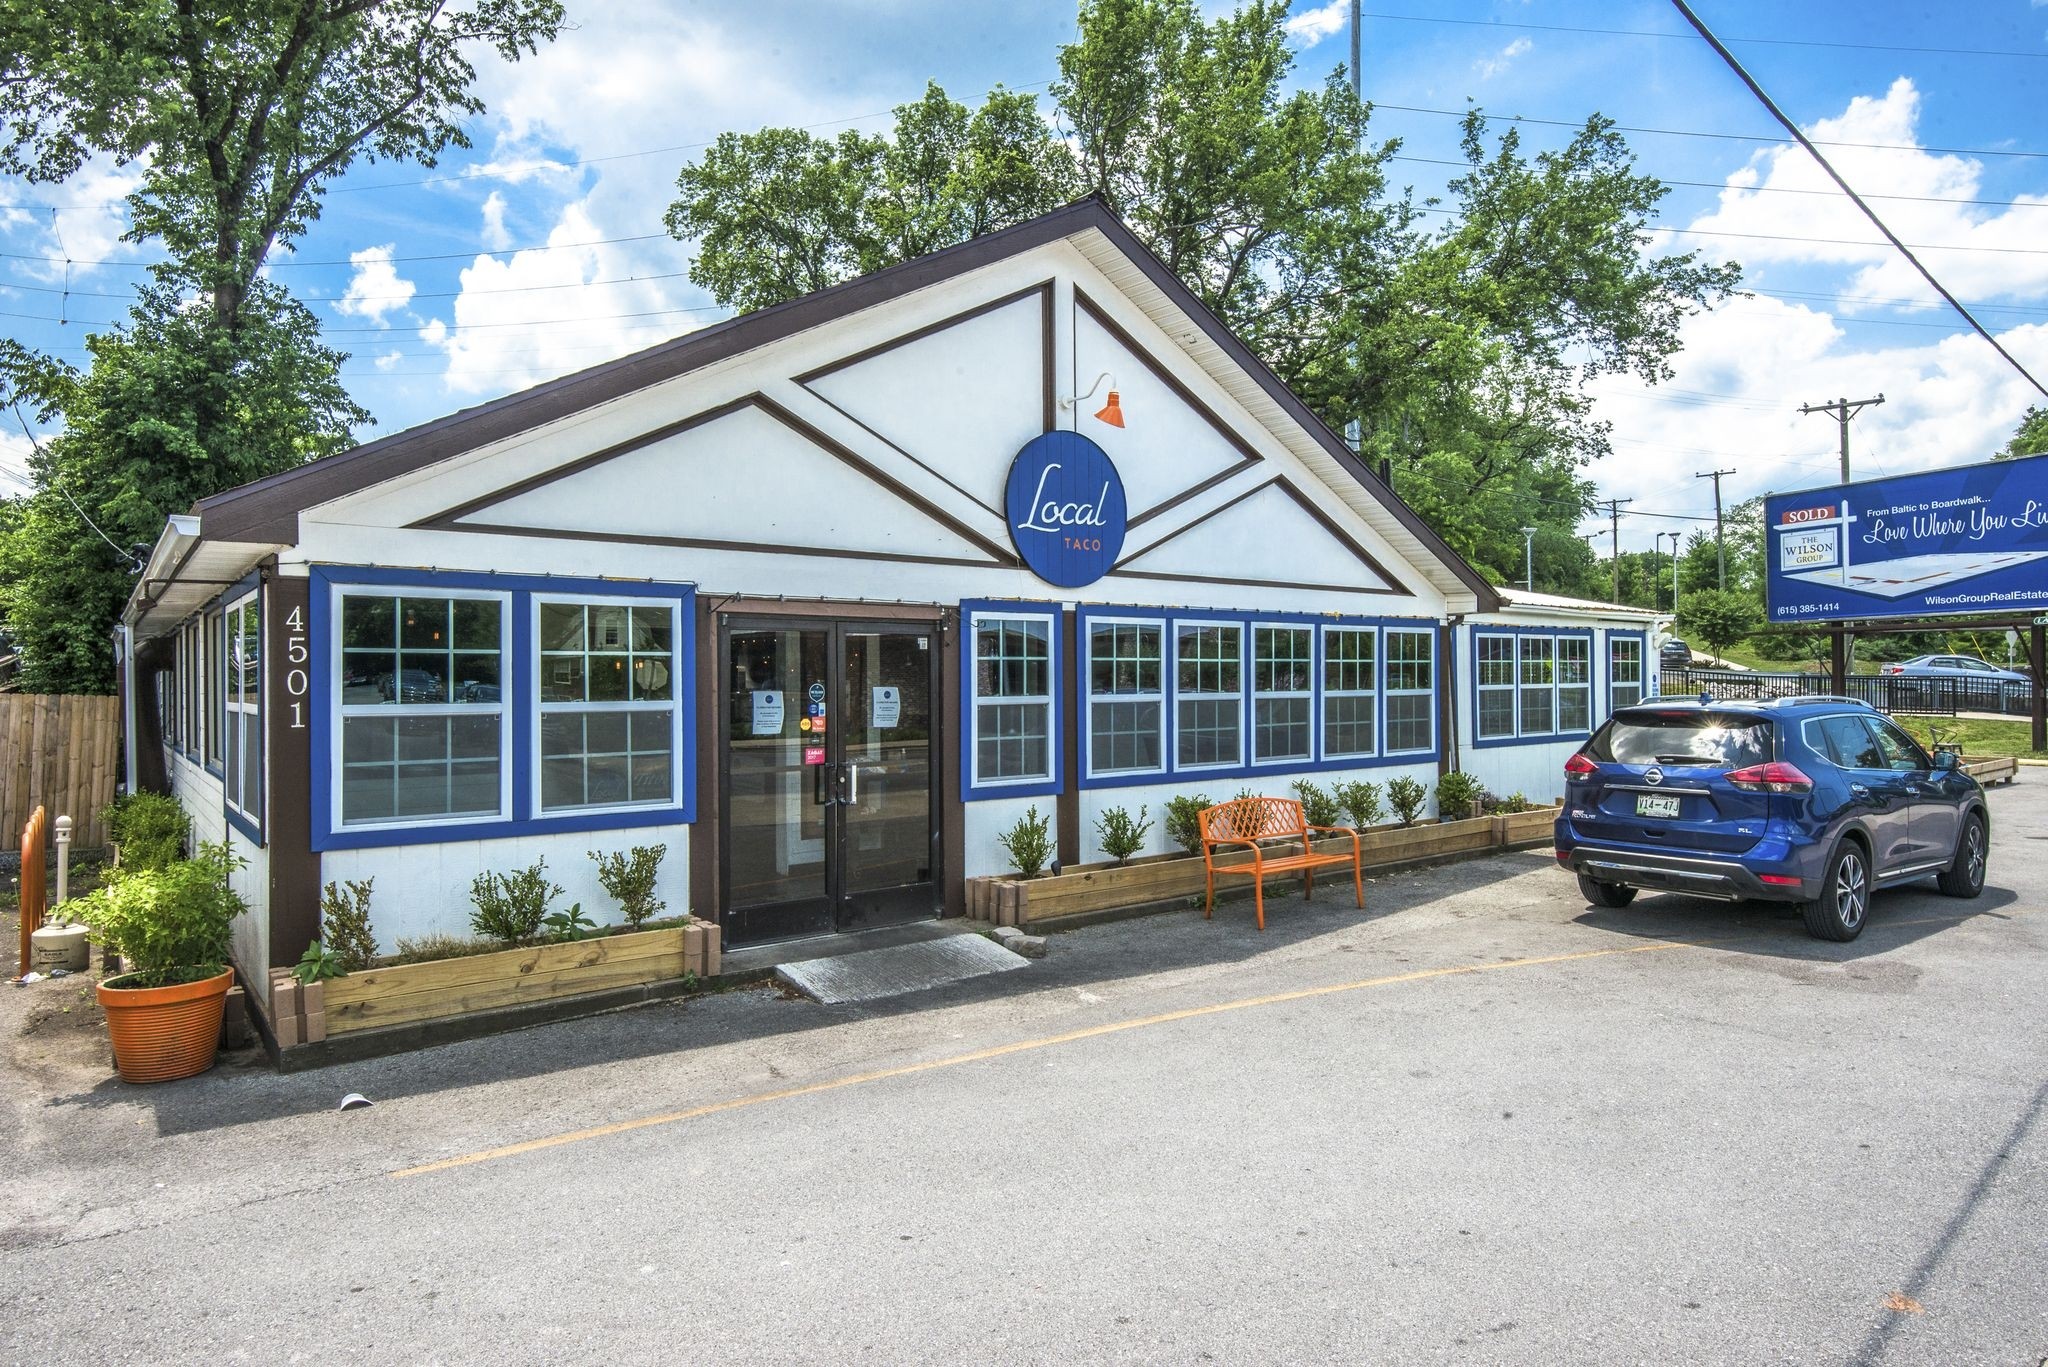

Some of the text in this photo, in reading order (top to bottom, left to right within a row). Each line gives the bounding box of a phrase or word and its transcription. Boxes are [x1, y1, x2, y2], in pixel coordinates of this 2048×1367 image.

[1017, 463, 1109, 532] Local
[1866, 509, 1889, 517] From
[1891, 505, 1917, 514] Baltic
[1931, 495, 1991, 509] Boardwalk...
[1788, 508, 1829, 523] SOLD
[1863, 518, 1908, 543] Love
[1913, 512, 1965, 539] Where
[1969, 507, 2007, 540] You
[1064, 538, 1101, 551] TACO
[1801, 536, 1818, 544] THE
[1785, 543, 1833, 556] WILSON
[1796, 554, 1824, 564] GROUP
[1777, 602, 1840, 616] (615) 385-1414
[285, 605, 308, 728] 4501
